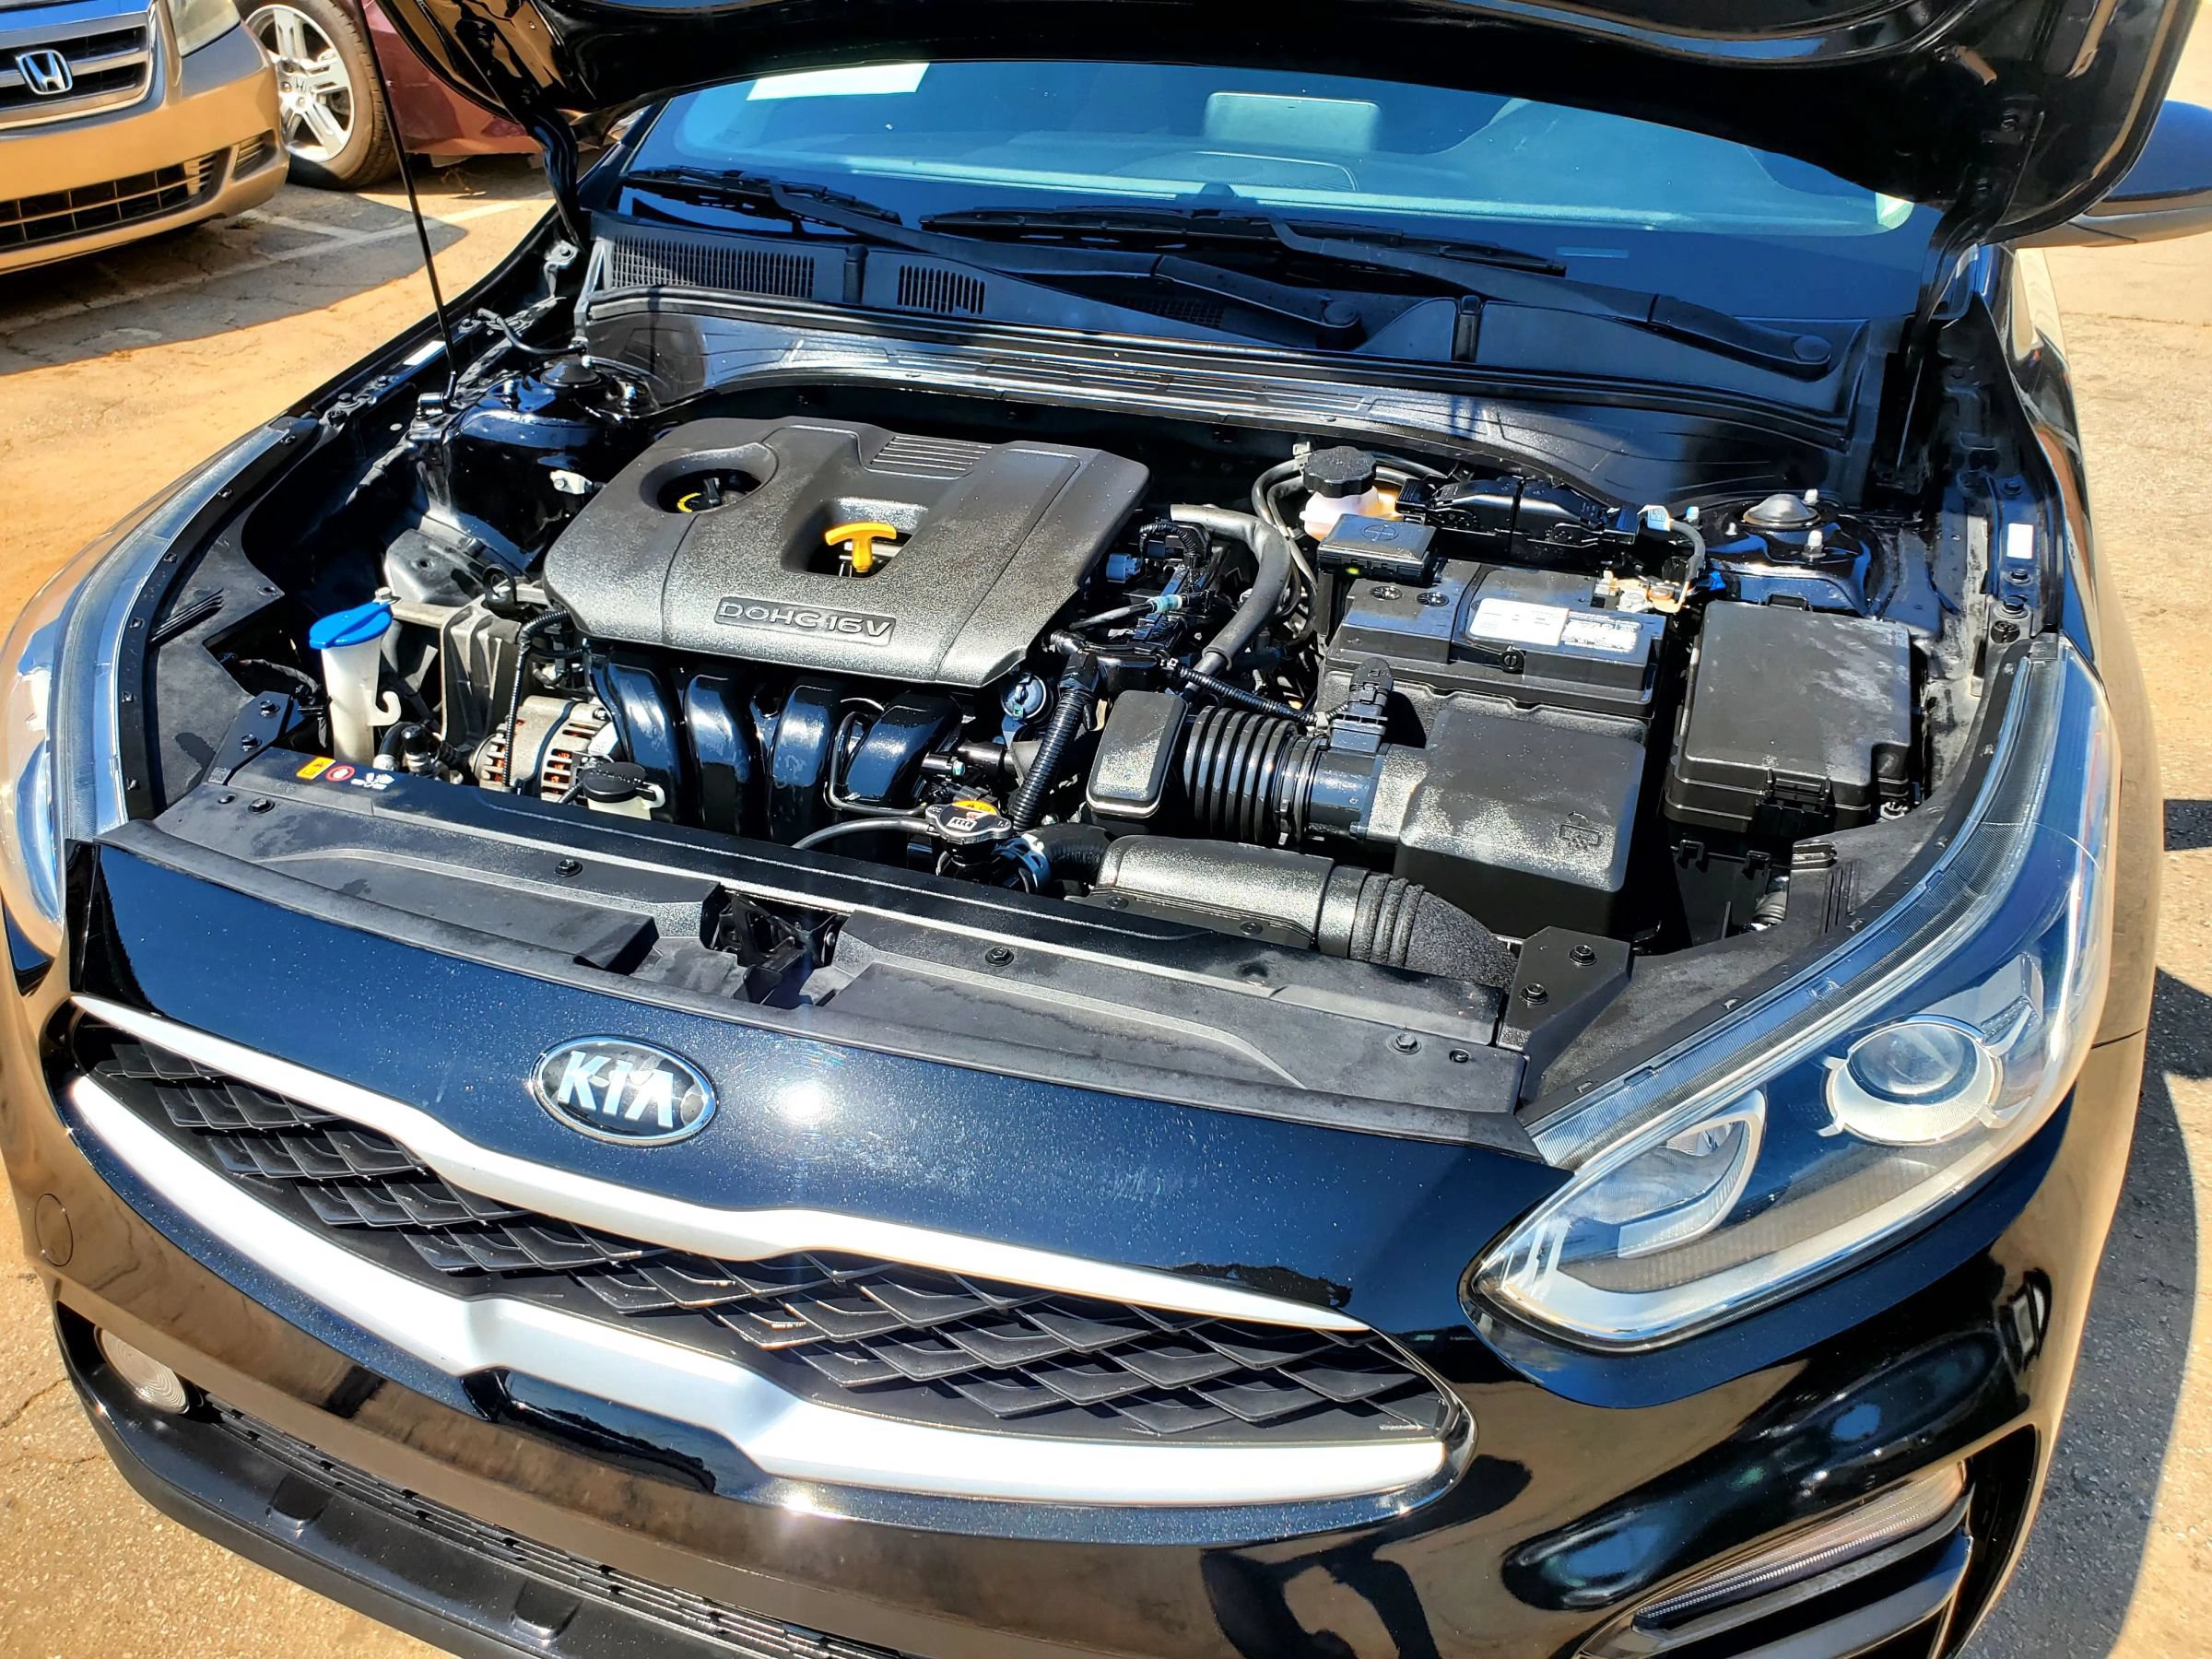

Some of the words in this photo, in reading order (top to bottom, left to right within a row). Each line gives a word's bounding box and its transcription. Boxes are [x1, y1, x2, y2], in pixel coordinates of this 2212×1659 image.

[717, 601, 820, 629] DOHC
[828, 614, 892, 638] 16V
[557, 1050, 675, 1129] KIA
